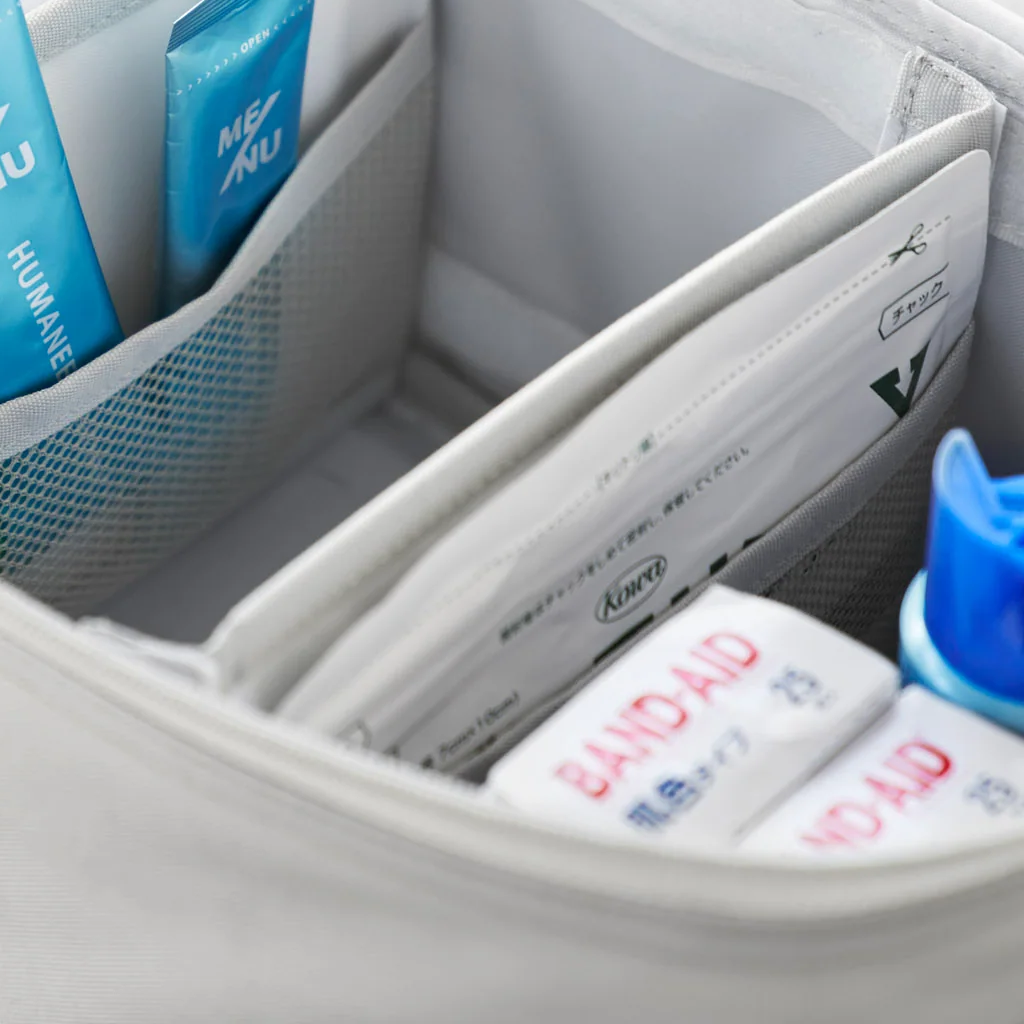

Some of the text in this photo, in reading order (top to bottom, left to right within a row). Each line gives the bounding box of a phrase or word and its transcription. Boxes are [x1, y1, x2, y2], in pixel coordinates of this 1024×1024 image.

[240, 28, 270, 54] OPEN
[892, 281, 944, 325] チャック
[601, 559, 665, 622] Kowa
[553, 631, 762, 800] BAND-AID
